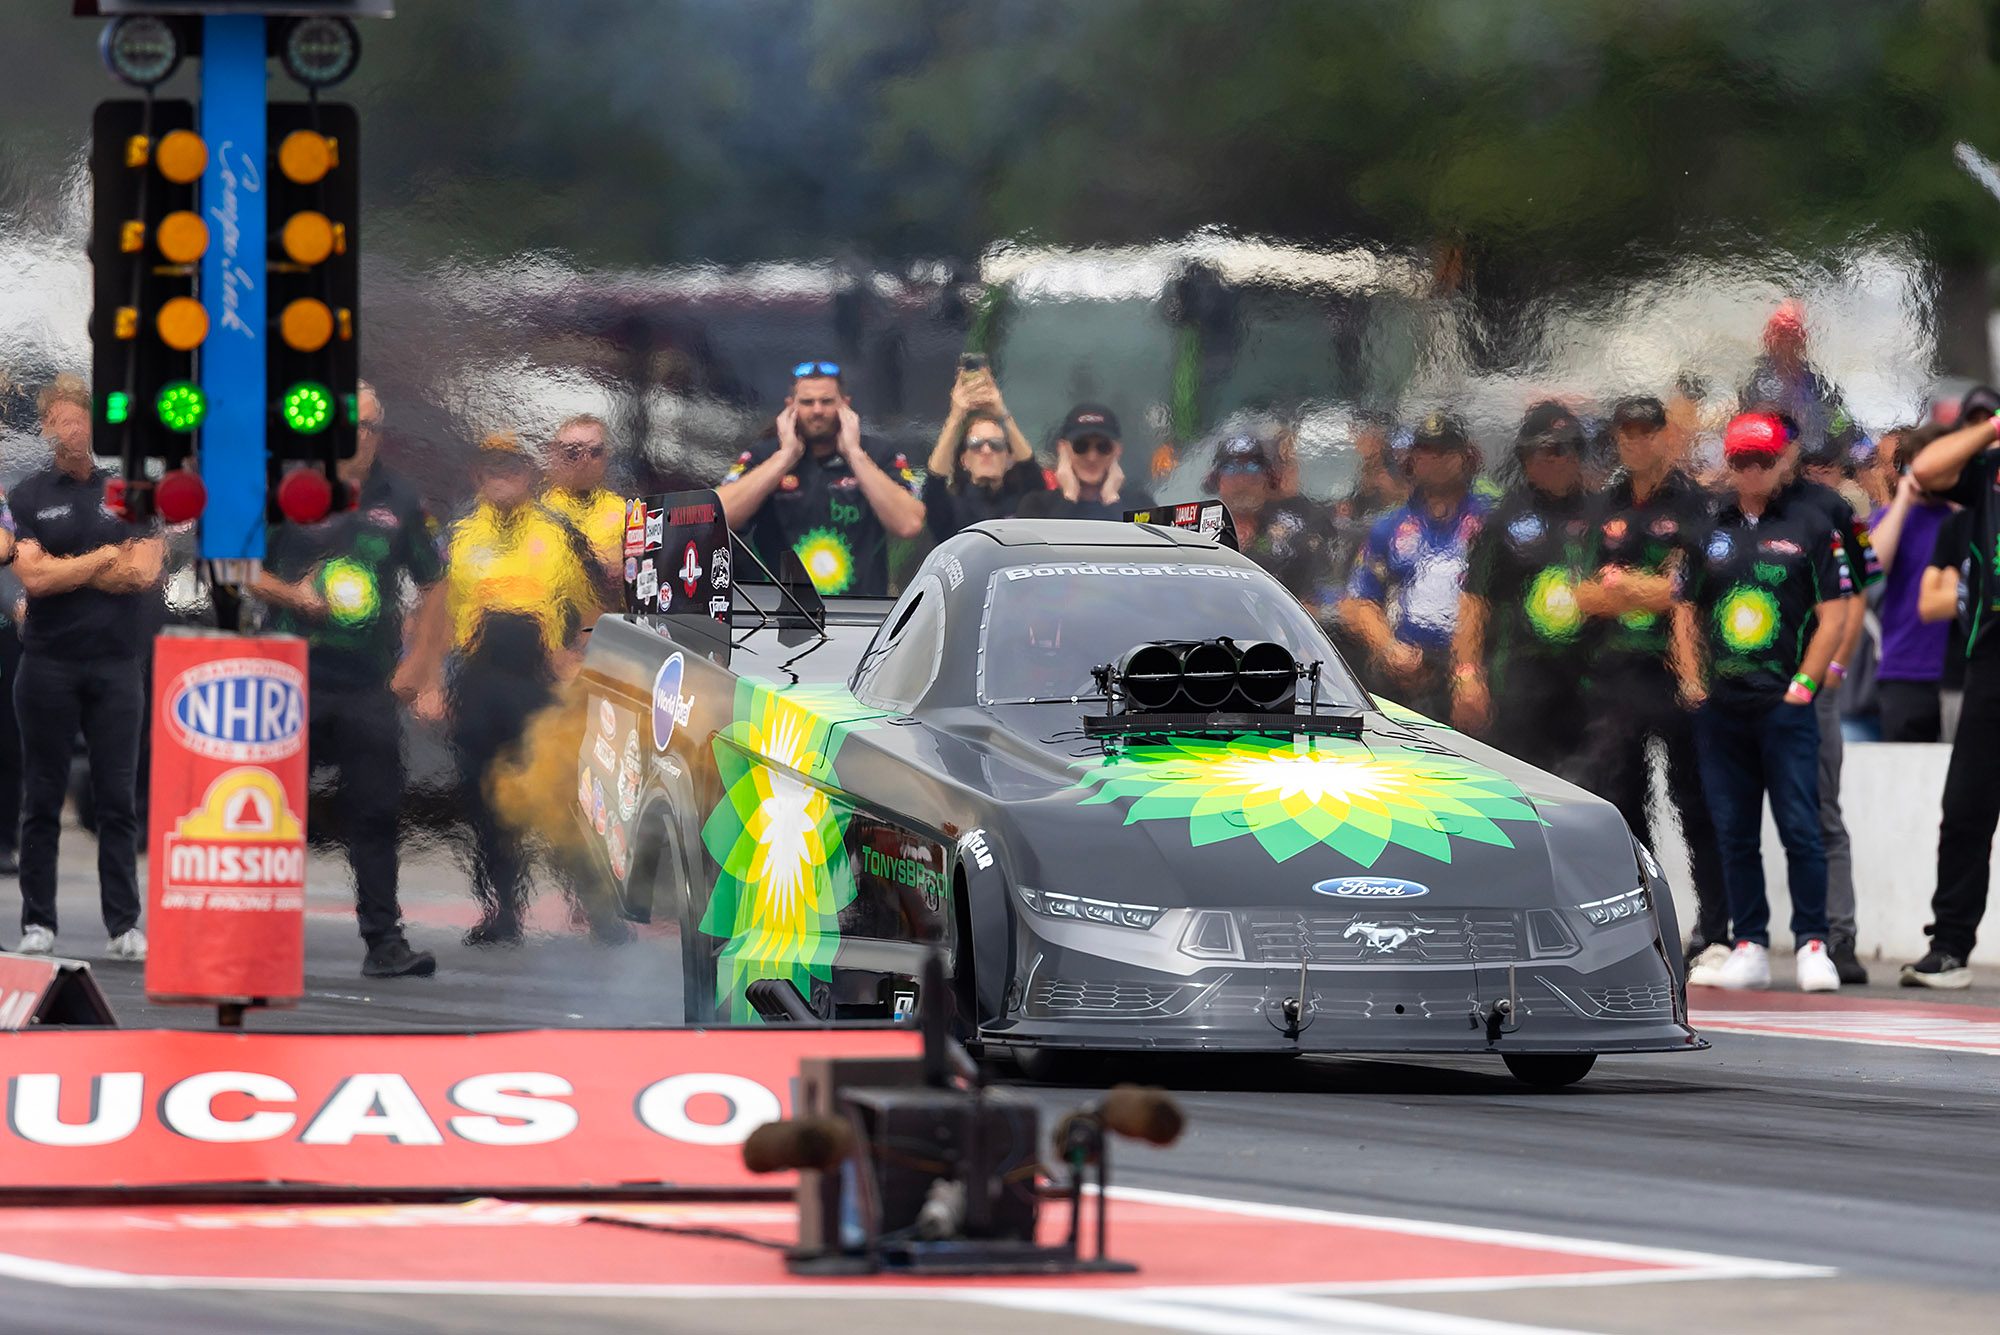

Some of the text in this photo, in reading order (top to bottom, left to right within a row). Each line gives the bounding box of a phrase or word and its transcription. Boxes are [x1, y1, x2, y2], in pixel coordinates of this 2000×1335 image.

[830, 499, 860, 523] bp
[186, 679, 302, 740] NHRA
[656, 688, 676, 717] World
[170, 843, 305, 883] MISSION
[1336, 880, 1406, 896] Ford
[6, 1070, 800, 1147] UCAS O
